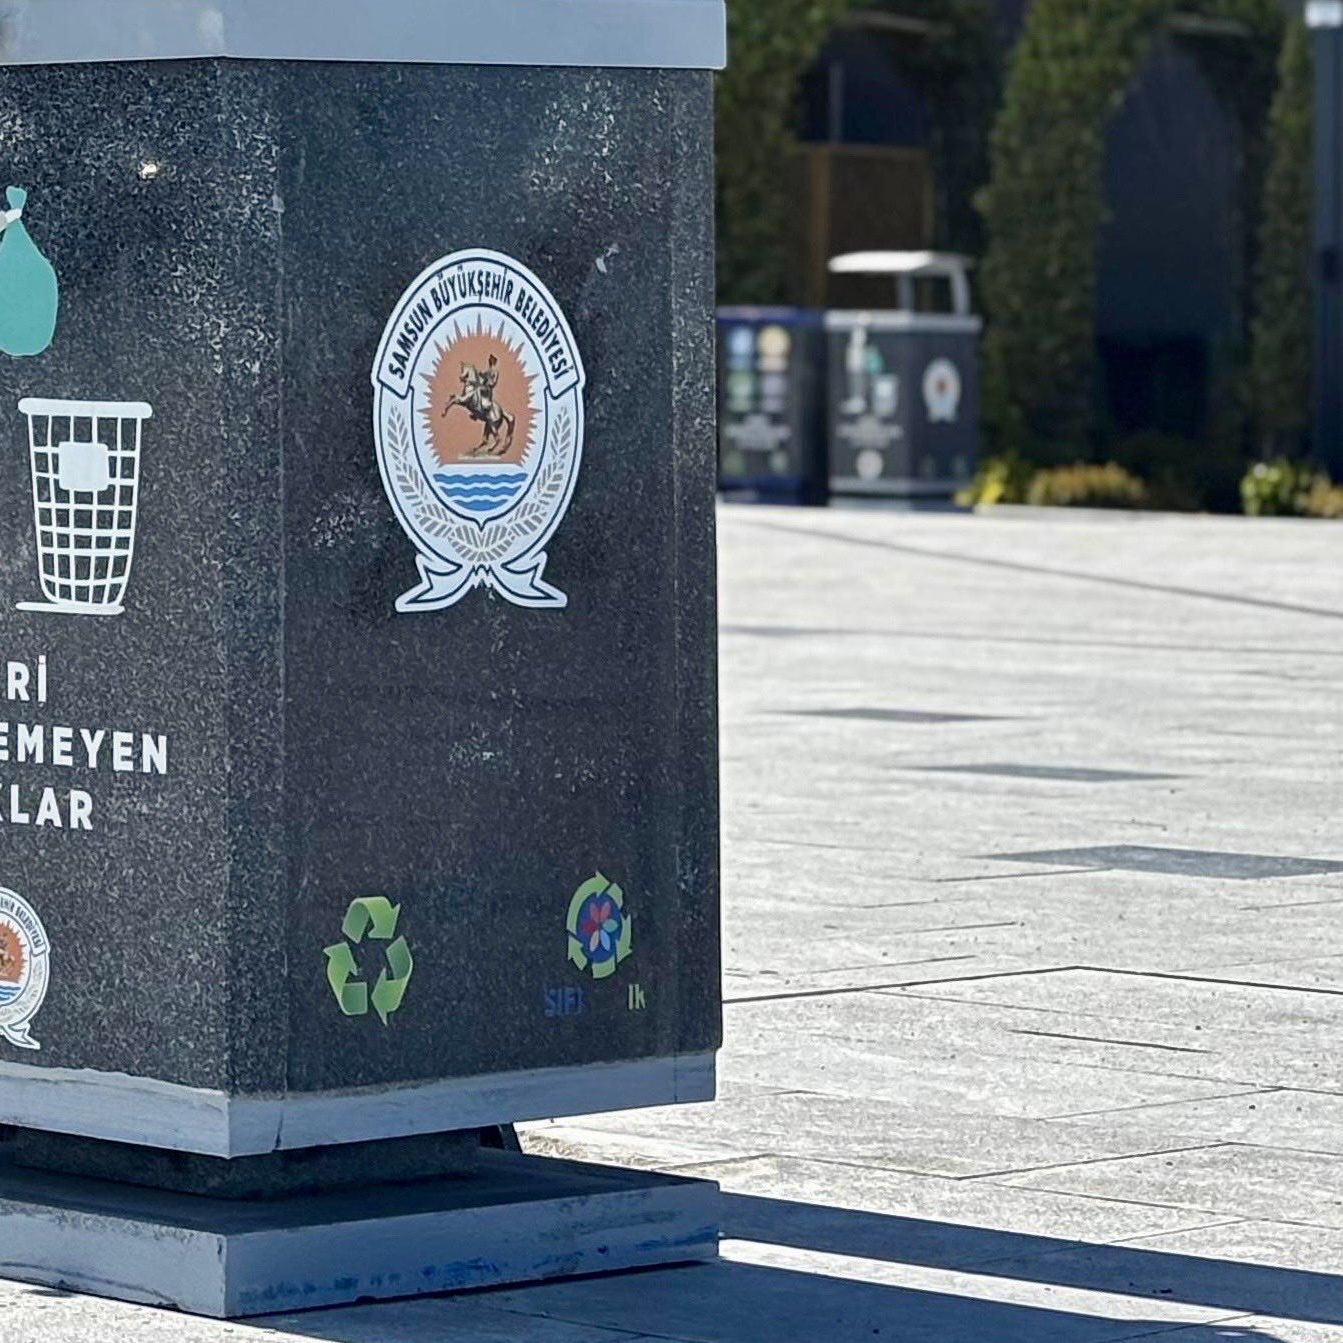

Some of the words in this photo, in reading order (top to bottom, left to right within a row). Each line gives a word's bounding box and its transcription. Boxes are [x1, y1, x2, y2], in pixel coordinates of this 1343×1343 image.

[388, 299, 433, 380] SAMSUN
[430, 266, 513, 313] BÜYÜKŞEHİR
[515, 287, 574, 380] BELEDİYESİ
